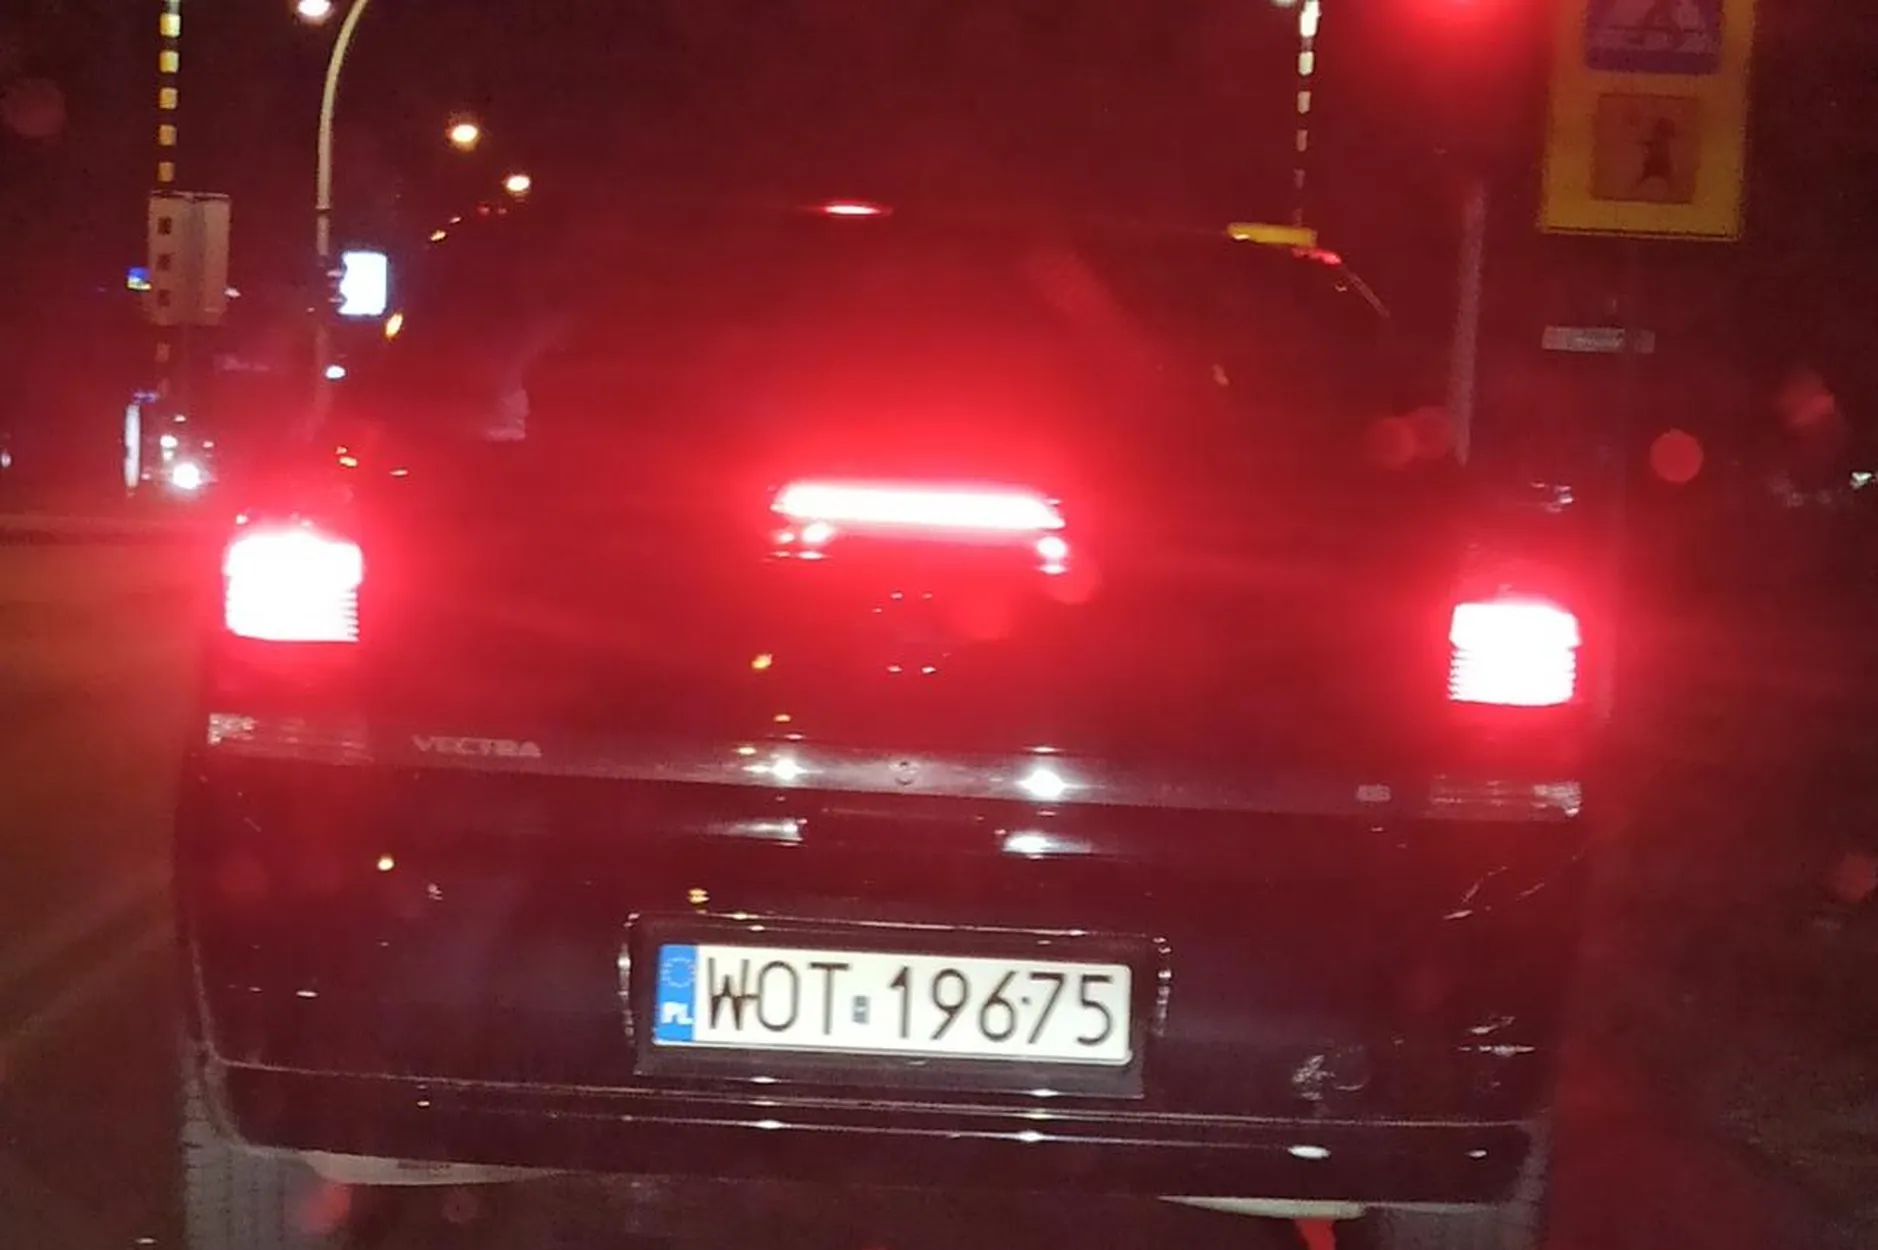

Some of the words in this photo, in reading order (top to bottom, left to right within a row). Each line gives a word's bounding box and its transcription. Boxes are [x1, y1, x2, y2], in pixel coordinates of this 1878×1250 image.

[661, 1003, 694, 1024] PL
[707, 957, 849, 1034] WOT
[888, 967, 1114, 1046] 19675
